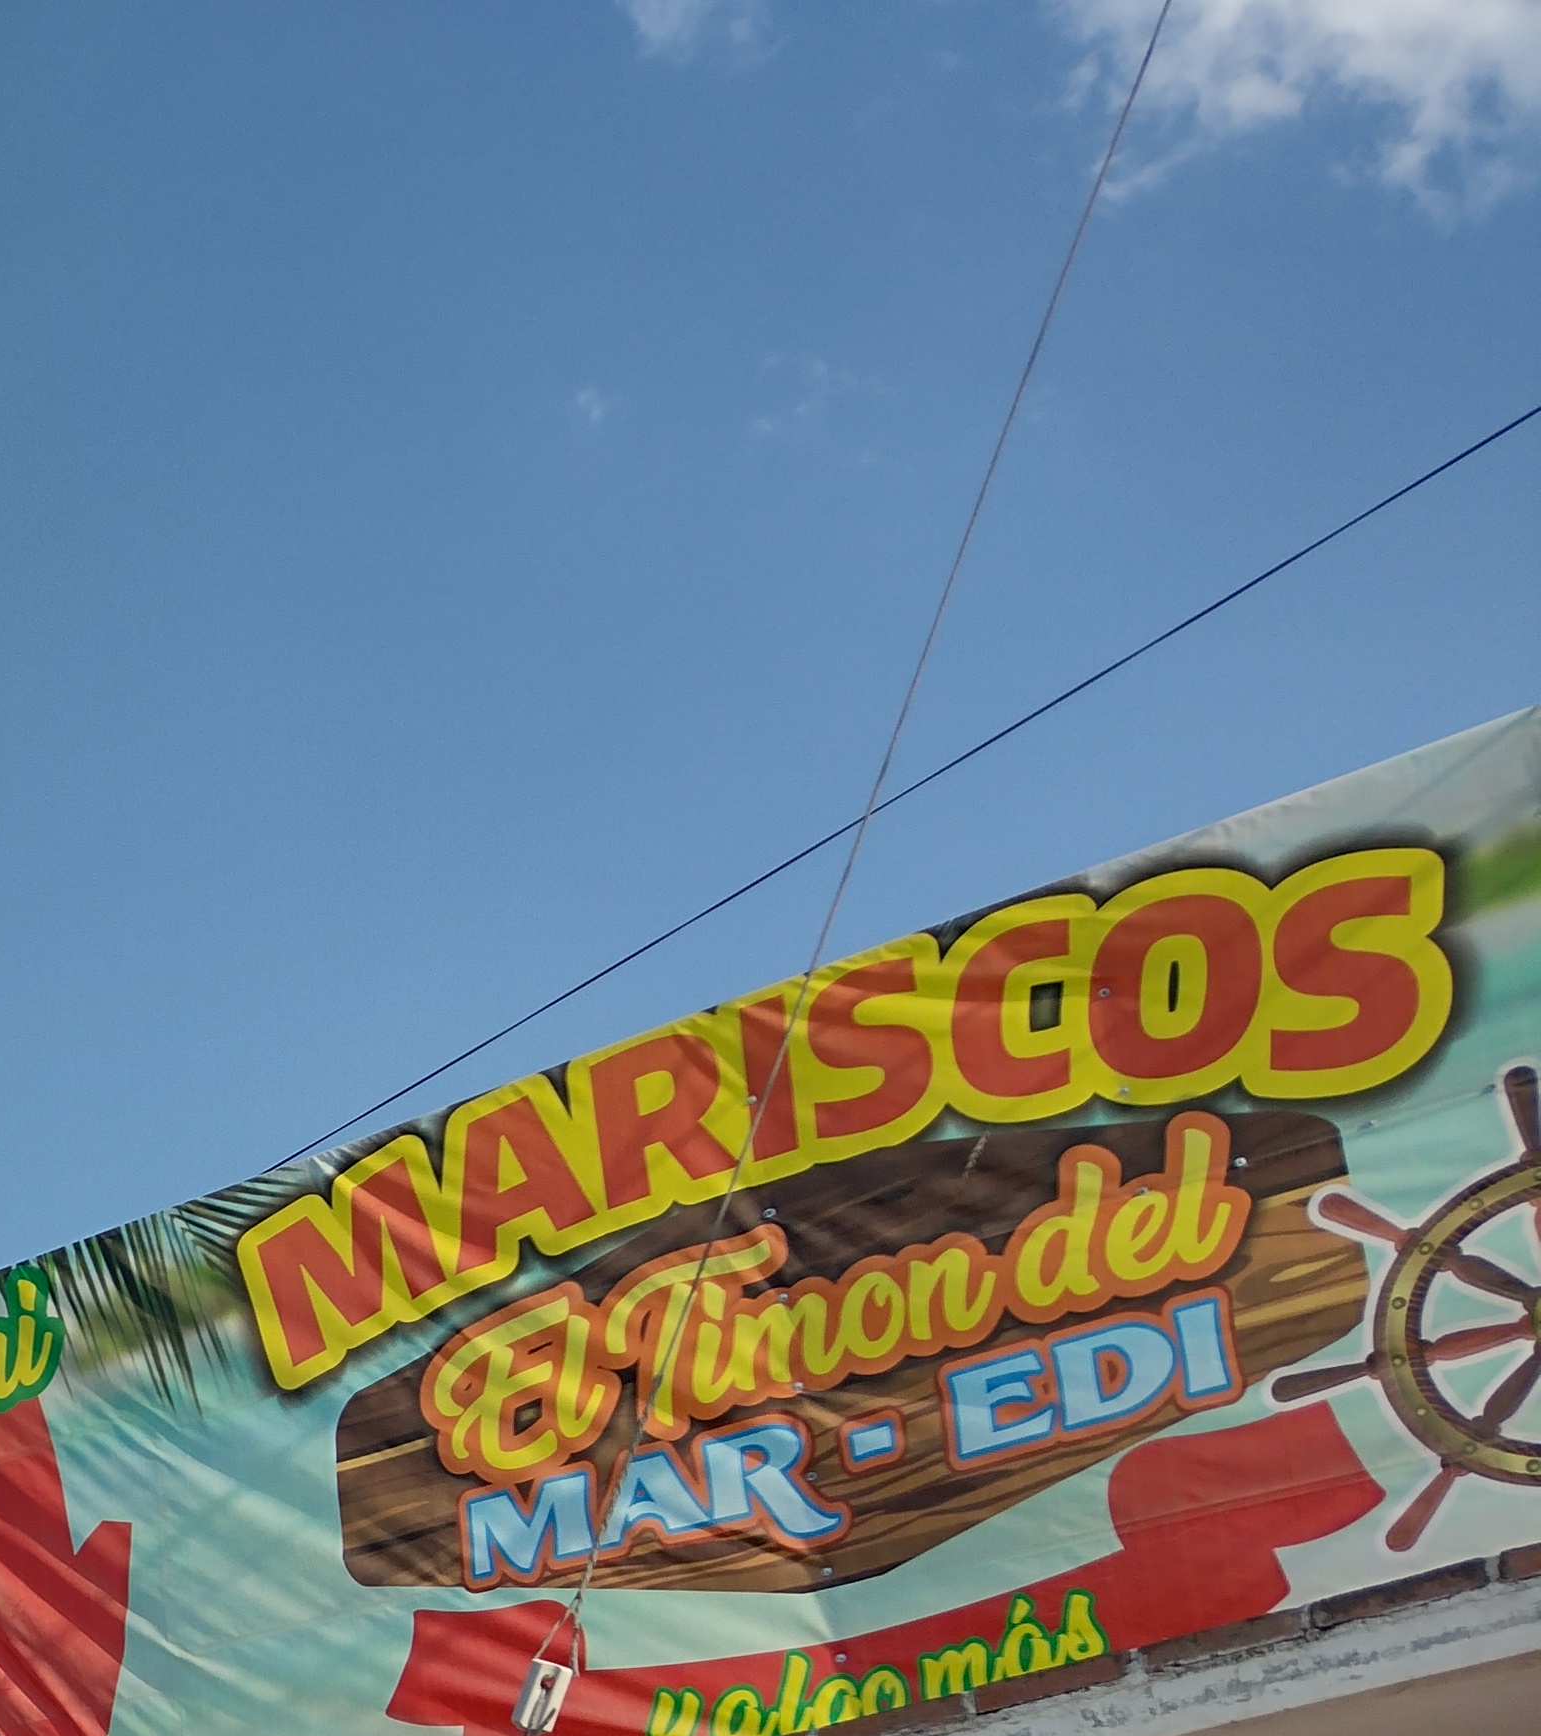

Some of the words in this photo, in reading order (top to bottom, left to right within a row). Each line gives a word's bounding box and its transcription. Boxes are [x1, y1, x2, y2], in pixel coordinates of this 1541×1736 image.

[245, 862, 1437, 1380] MARISCOS
[431, 1295, 621, 1472] El
[603, 1236, 997, 1429] Timon
[1013, 1126, 1232, 1309] del
[465, 1420, 845, 1582] MAR
[946, 1296, 1235, 1462] EDI
[920, 1589, 1110, 1700] más
